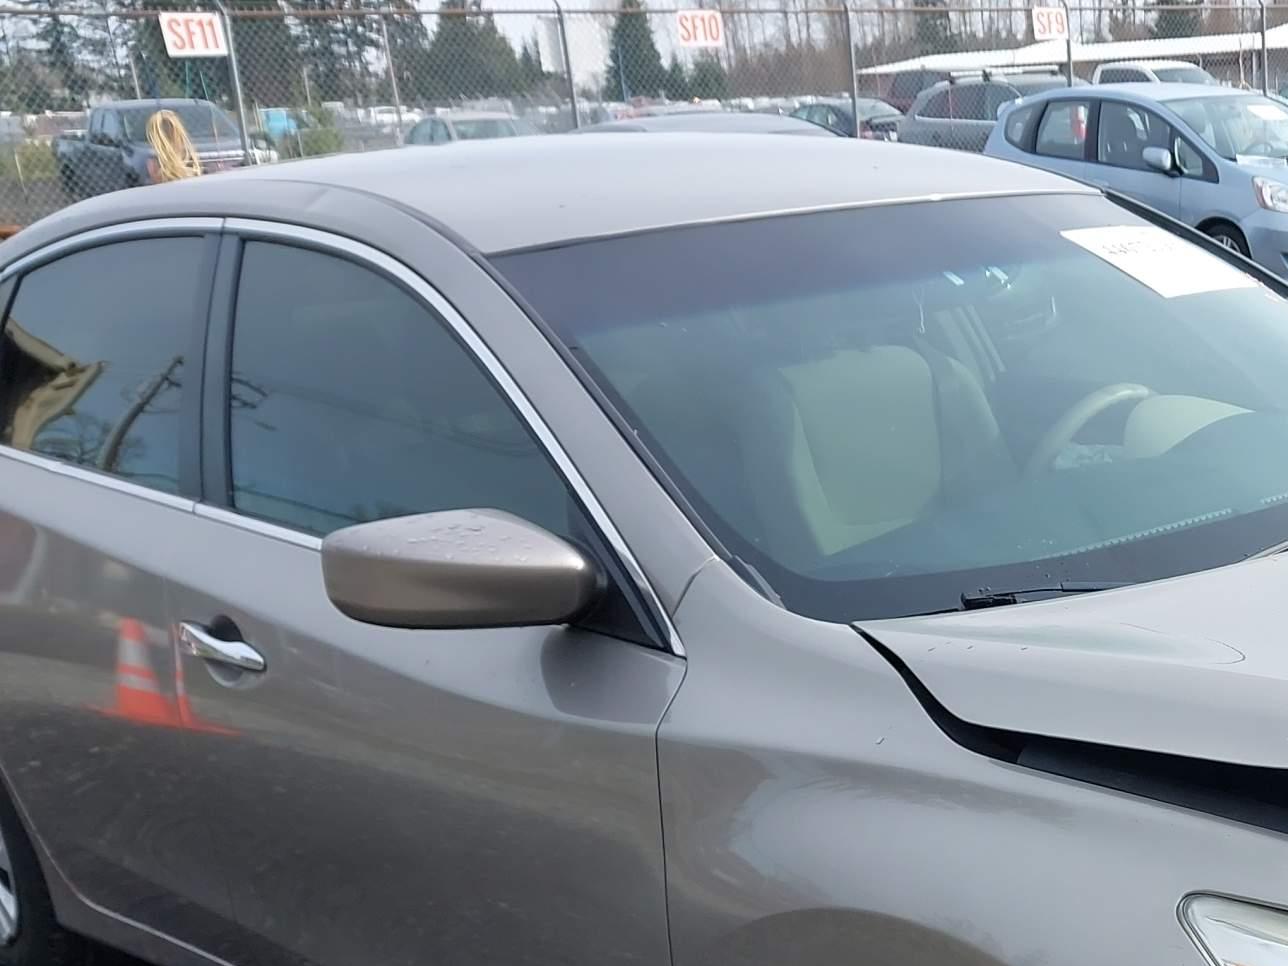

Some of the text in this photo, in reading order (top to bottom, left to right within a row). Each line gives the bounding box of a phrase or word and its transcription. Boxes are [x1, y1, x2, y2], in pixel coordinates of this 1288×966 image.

[168, 18, 220, 49] SF11
[678, 14, 721, 42] SF10
[1036, 10, 1064, 34] SF9
